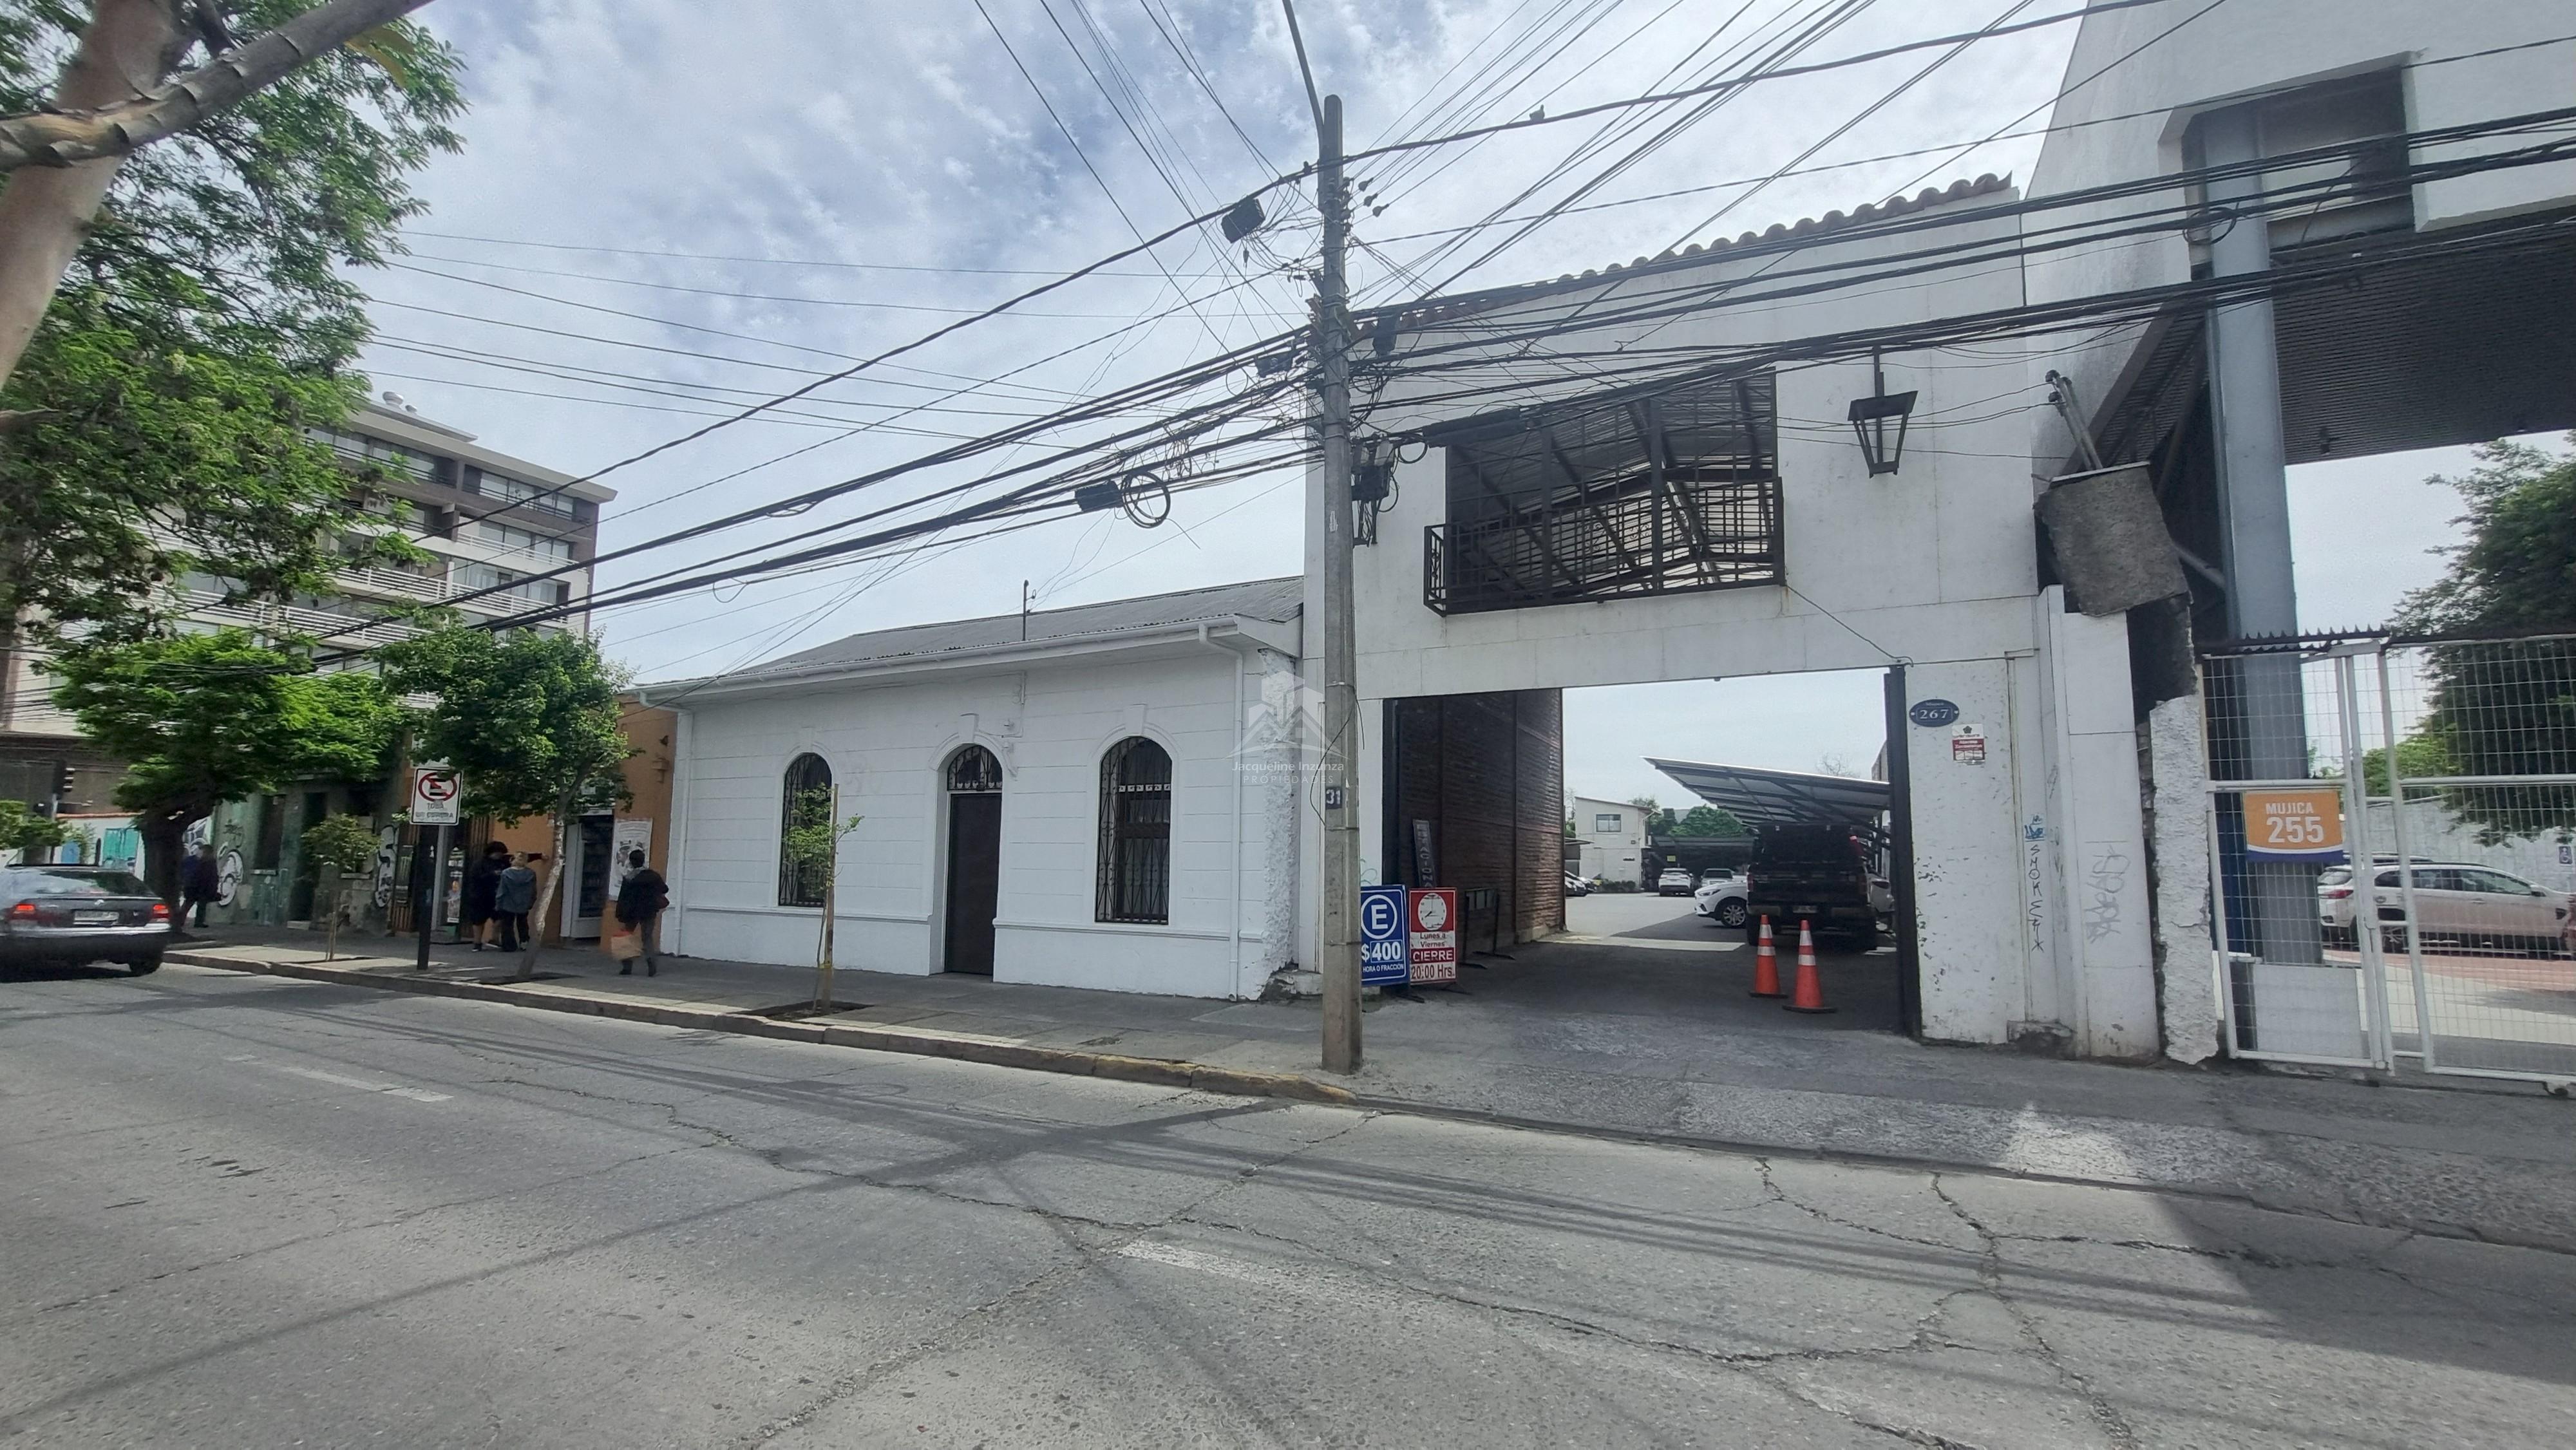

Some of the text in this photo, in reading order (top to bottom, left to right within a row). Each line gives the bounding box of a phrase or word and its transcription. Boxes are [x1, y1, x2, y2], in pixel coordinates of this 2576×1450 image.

[1920, 709, 1949, 719] 267
[1326, 789, 1341, 805] 31
[2266, 802, 2314, 814] MUJICA
[2266, 816, 2324, 843] 255
[1371, 904, 1388, 930] E
[1420, 932, 1440, 940] Lunes
[1412, 950, 1454, 962] CIERRE
[1411, 965, 1435, 979] 20:00
